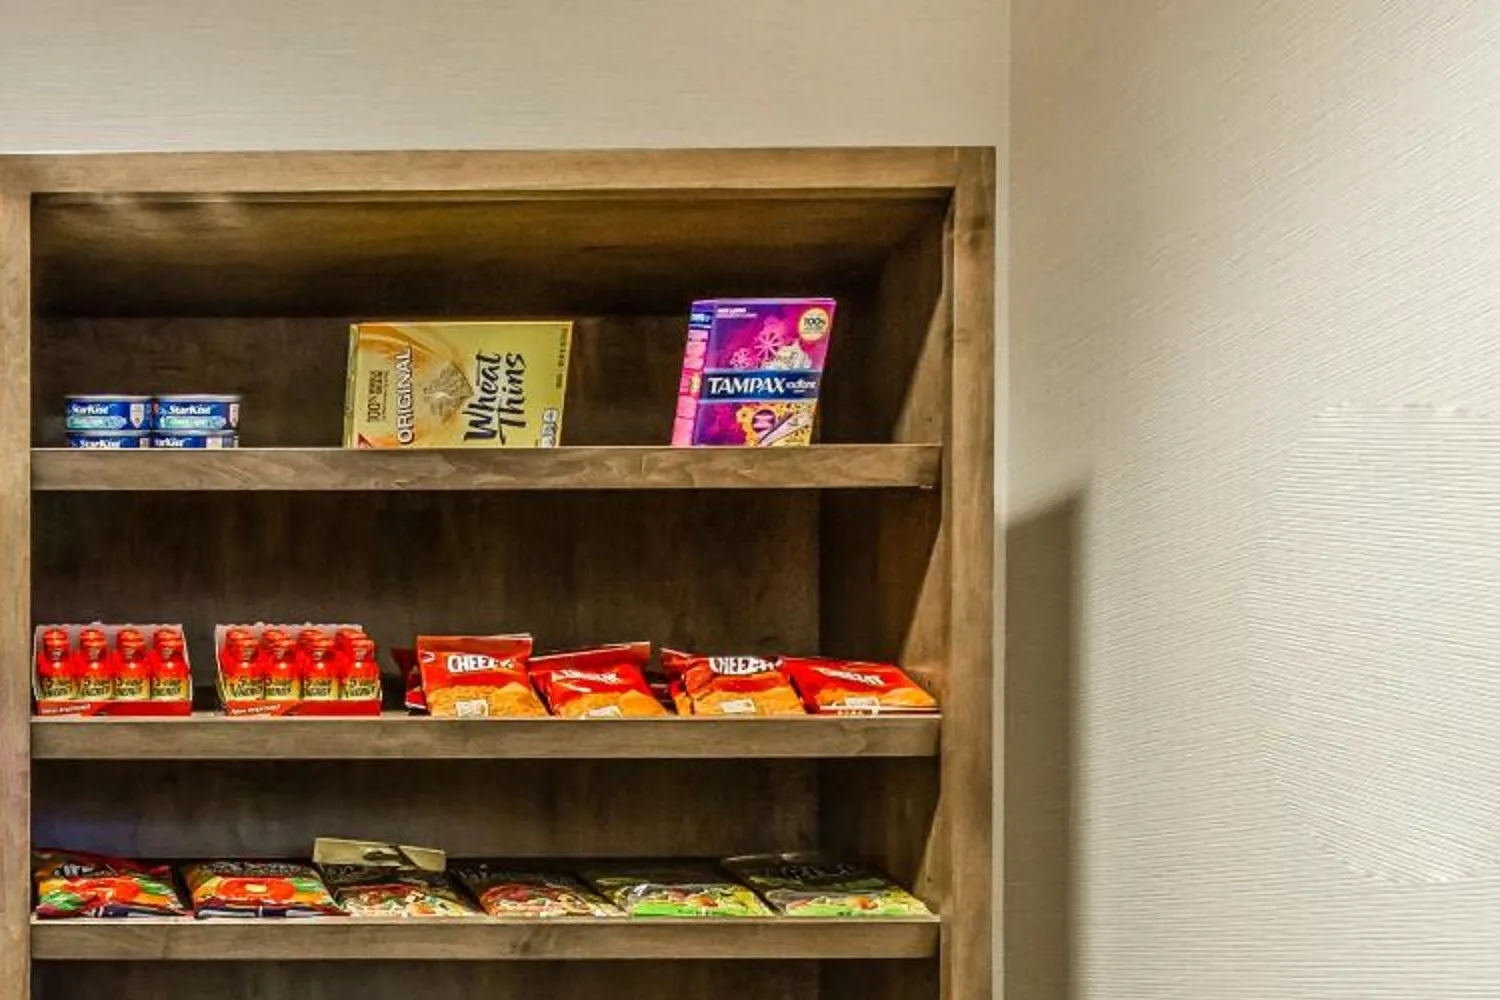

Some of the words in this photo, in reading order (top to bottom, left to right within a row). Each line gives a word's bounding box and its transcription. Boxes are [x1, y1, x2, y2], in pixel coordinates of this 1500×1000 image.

[169, 404, 212, 415] StarKist
[396, 347, 414, 444] ORIGINAL
[463, 351, 501, 442] Wheat
[498, 352, 527, 445] Thins
[707, 376, 786, 395] TAMPAX
